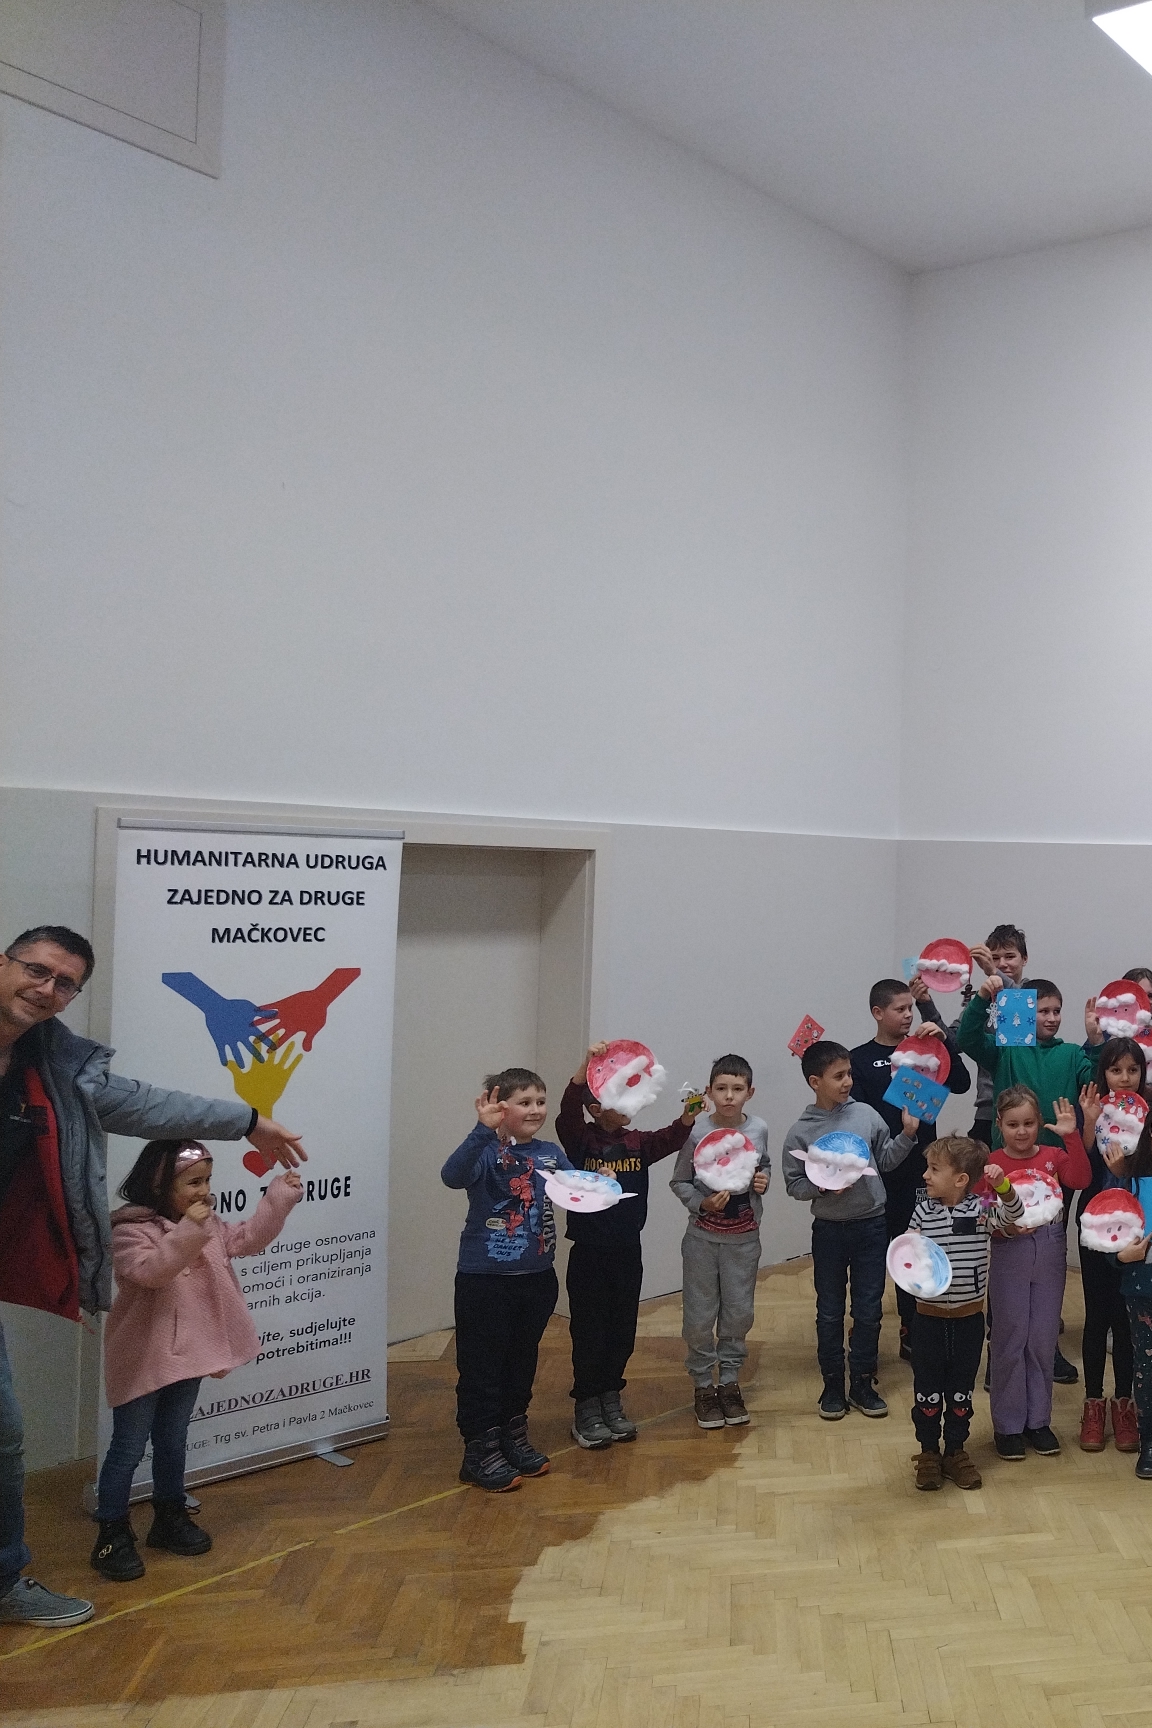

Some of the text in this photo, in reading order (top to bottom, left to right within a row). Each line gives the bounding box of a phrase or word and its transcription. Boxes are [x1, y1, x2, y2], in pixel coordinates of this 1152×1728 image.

[136, 848, 387, 871] HUMANITARNA UDRUGA
[166, 888, 366, 906] ZAJEDNO ZA DRUGE
[210, 923, 326, 944] MAČKOVEC
[584, 1157, 642, 1172] HOGWARTS
[297, 1176, 351, 1203] RUGE
[271, 1230, 376, 1255] druge osnovana
[241, 1246, 372, 1277] s ciljem prikupljanja
[242, 1277, 285, 1294] omoći
[297, 1263, 372, 1284] oraniziranja
[247, 1289, 325, 1311] arnih akcija.
[258, 1316, 356, 1346] jte, sudjelujte
[256, 1332, 352, 1364] potrebitima!!!
[213, 1433, 231, 1447] Trg
[234, 1430, 249, 1441] sv.
[252, 1420, 280, 1435] Petra
[288, 1413, 317, 1427] Pavla
[319, 1410, 326, 1420] 2
[328, 1400, 375, 1418] Mačkovec
